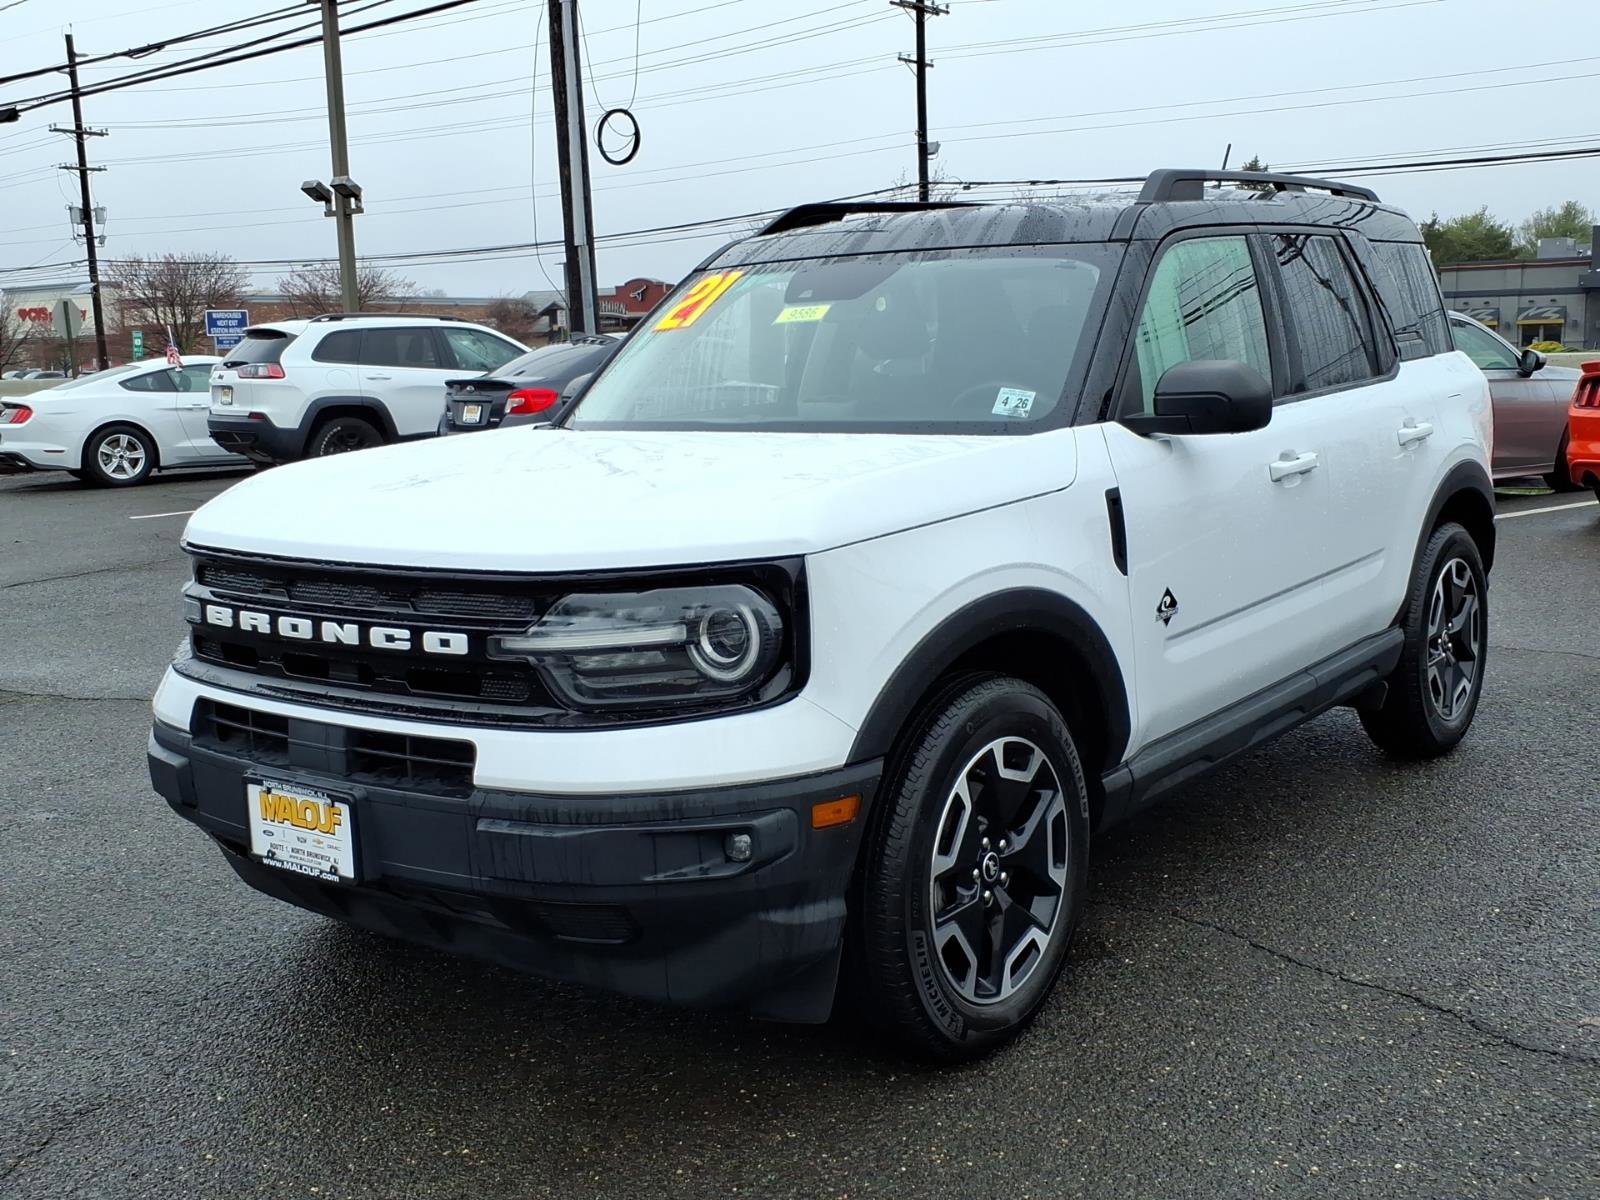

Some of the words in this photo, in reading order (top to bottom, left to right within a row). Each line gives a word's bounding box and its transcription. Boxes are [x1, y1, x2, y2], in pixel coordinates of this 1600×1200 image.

[652, 268, 745, 333] 21
[1001, 395, 1010, 407] 4
[1013, 397, 1029, 409] 26
[205, 604, 469, 656] BRONCO
[1063, 736, 1088, 813] MICHELIN
[259, 790, 342, 836] MALOUF
[262, 857, 340, 882] www.MALOUF.com
[914, 936, 950, 1019] MICHELIN
